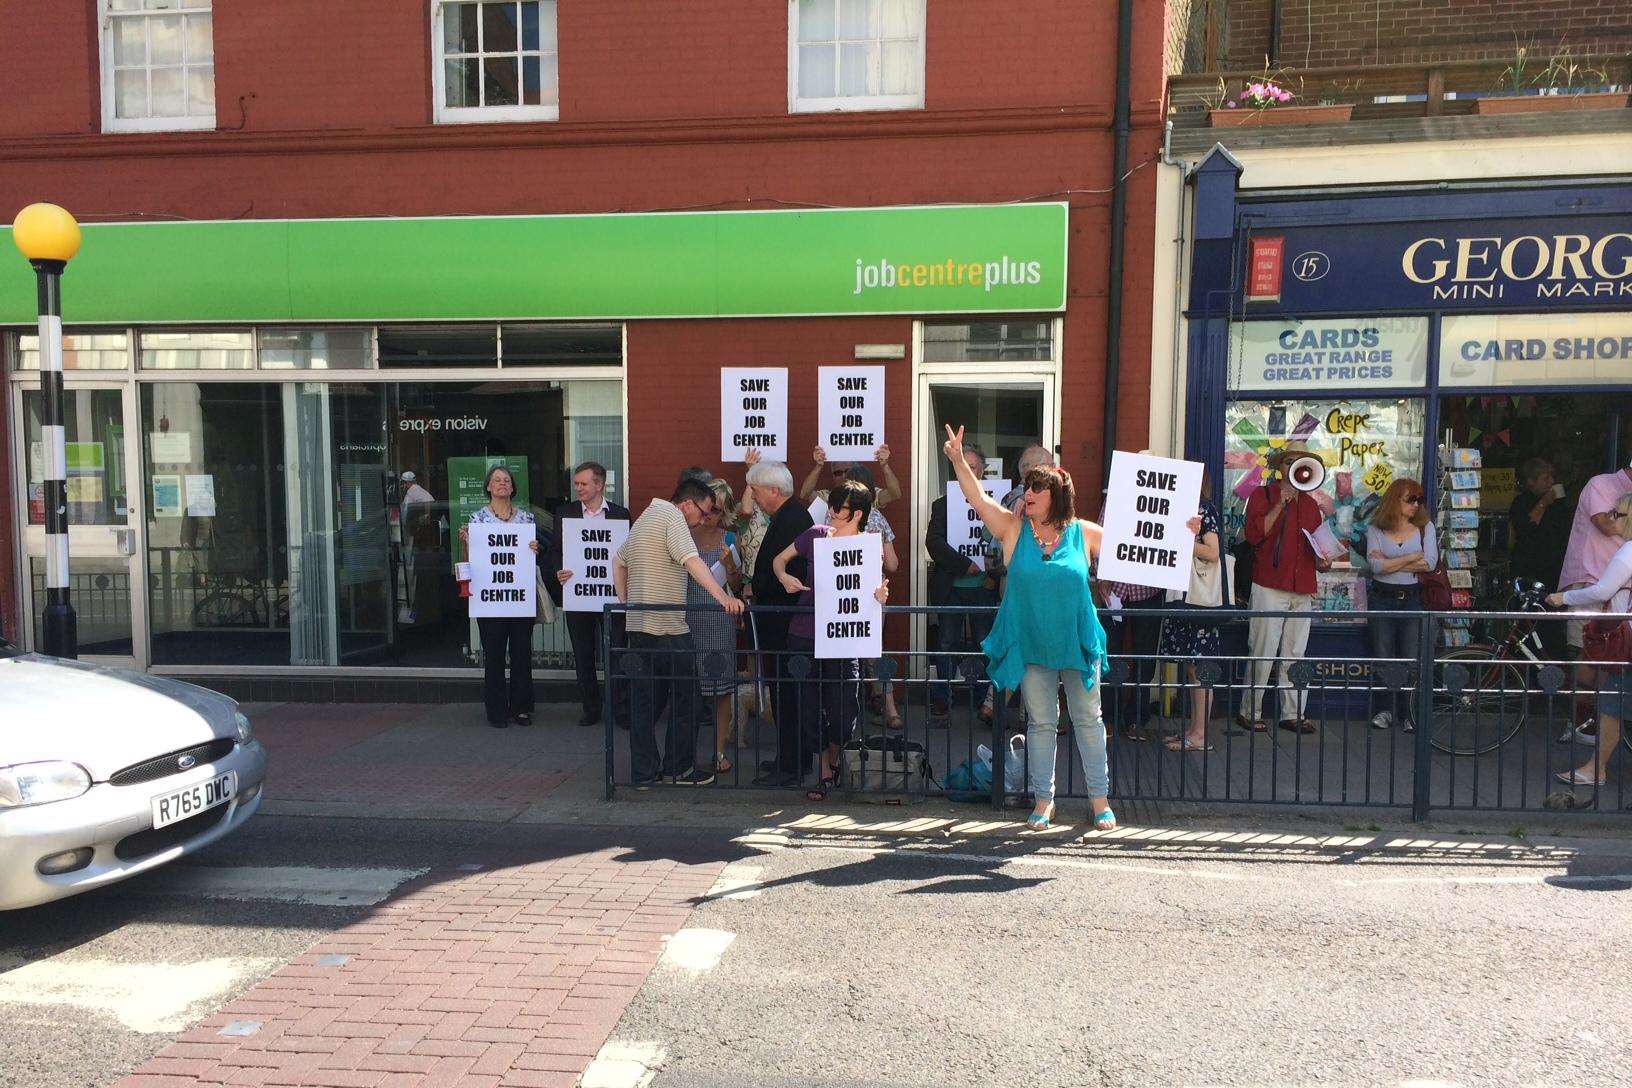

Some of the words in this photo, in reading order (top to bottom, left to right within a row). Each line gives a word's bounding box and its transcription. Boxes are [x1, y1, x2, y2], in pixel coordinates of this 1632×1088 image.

[1300, 257, 1320, 277] 15
[853, 256, 1041, 294] jobcentreplus
[1433, 285, 1504, 300] MINI
[1537, 281, 1632, 298] MARK
[1279, 327, 1380, 351] CARDS
[1461, 338, 1547, 362] CARD
[1265, 352, 1326, 366] GREAT
[1329, 350, 1393, 364] RANGE
[1263, 367, 1325, 381] GREAT
[1327, 365, 1394, 380] PRICES
[740, 379, 770, 392] SAVE
[837, 377, 868, 391] SAVE
[742, 397, 767, 410] OUR
[839, 396, 864, 409] OUR
[744, 416, 766, 429] JOB
[841, 414, 863, 428] JOB
[733, 434, 777, 447] CENTRE
[830, 433, 874, 446] CENTRE
[1135, 469, 1177, 491] SAVE
[1136, 495, 1170, 516] OUR
[581, 529, 612, 543] SAVE
[969, 526, 983, 539] JO
[1134, 520, 1165, 541] JOB
[487, 534, 518, 547] SAVE
[584, 547, 609, 560] OUR
[958, 544, 987, 557] CENT
[1116, 543, 1178, 568] CENTRE
[491, 552, 515, 565] OUR
[833, 549, 863, 568] SAVE
[492, 570, 514, 584] JOB
[585, 565, 608, 579] JOB
[836, 574, 860, 591] OUR
[480, 589, 526, 602] CENTRE
[837, 598, 860, 615] JOB
[826, 621, 871, 638] CENTRE
[160, 787, 202, 822] R765
[205, 776, 230, 805] DWC
